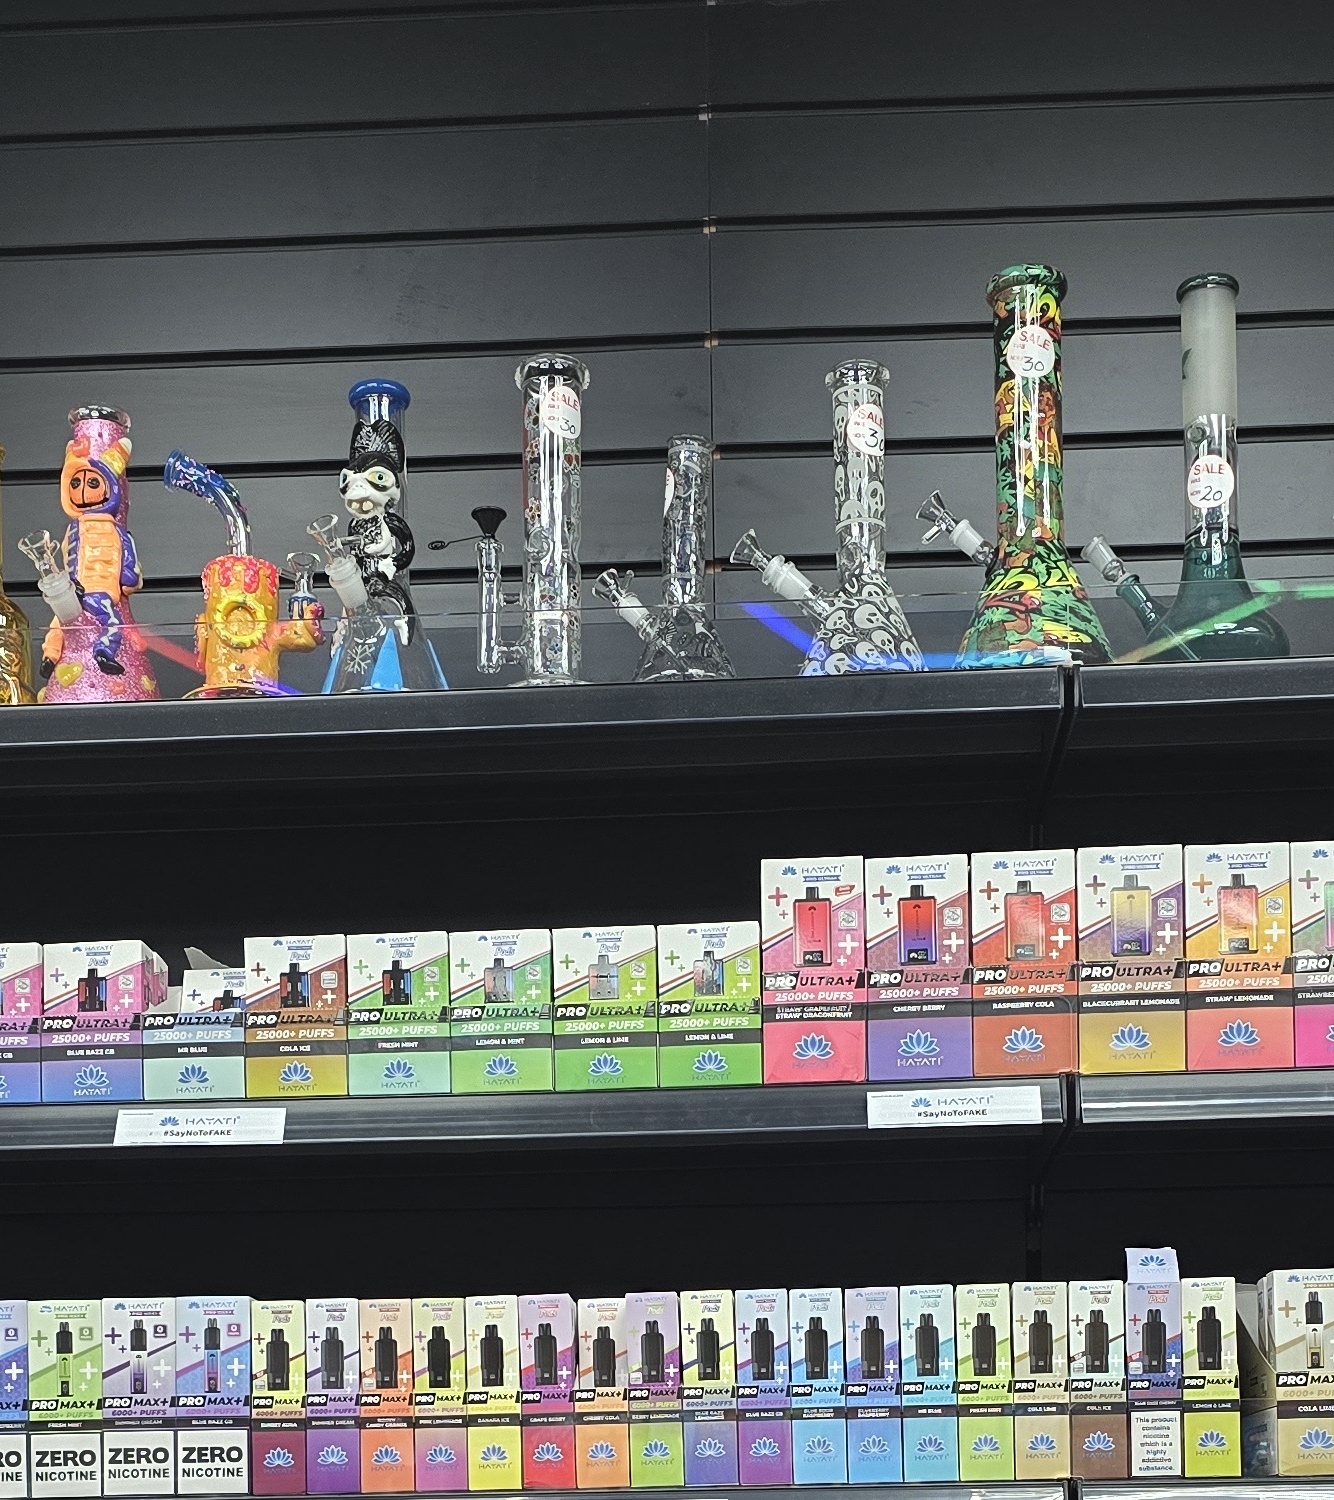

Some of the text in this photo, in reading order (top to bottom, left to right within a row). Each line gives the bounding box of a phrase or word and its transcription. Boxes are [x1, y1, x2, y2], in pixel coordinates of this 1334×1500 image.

[917, 1108, 987, 1118] #SayNoToFAKE
[105, 1397, 169, 1408] PRO MAX+
[109, 1448, 169, 1464] ZERO
[182, 1447, 243, 1463] ZERO
[108, 1468, 169, 1479] NICOTINE
[182, 1467, 243, 1478] NICOTINE
